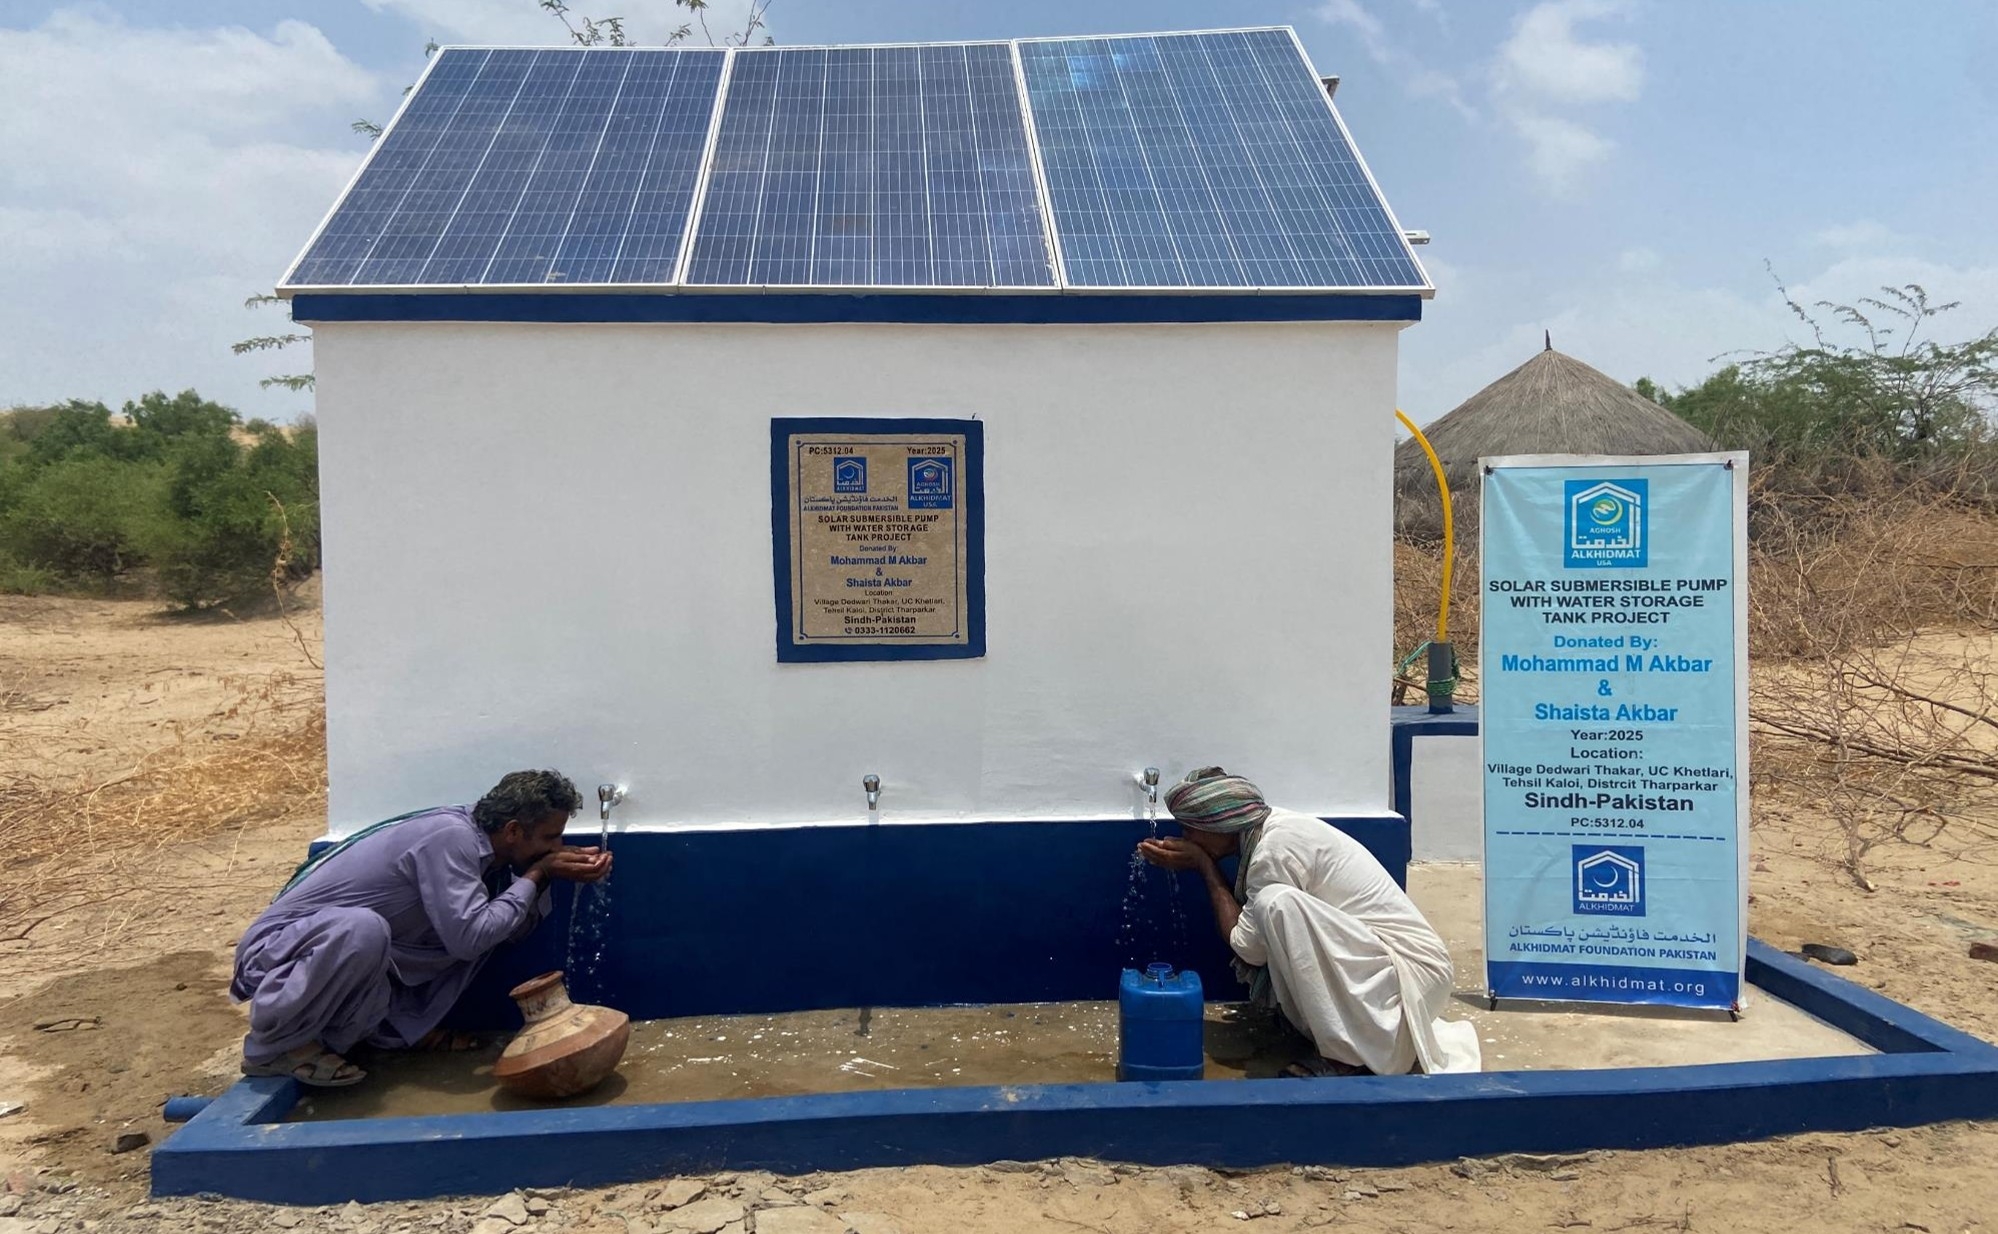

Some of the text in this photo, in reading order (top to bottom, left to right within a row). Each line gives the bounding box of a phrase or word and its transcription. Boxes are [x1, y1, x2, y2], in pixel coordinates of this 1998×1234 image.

[809, 447, 854, 455] PC:5312.04
[907, 447, 946, 455] Year:2025
[818, 515, 848, 523] SOLAR
[850, 515, 912, 523] SUBMERSIBLE
[829, 524, 929, 532] WITH WATER STORAGE
[871, 533, 912, 541] PROJECT
[830, 555, 927, 565] Mohammad M Akbar
[1571, 550, 1641, 559] ALKHIDMAT
[875, 568, 883, 576] &
[846, 578, 912, 588] Shaista Akbar
[1489, 579, 1727, 592] SOLAR SUBMERSIBLE PUMP
[1510, 595, 1704, 608] WITH WATER STORAGE
[897, 606, 936, 614] Tharparkar
[844, 616, 916, 624] Sindh-Pakistan
[1543, 611, 1670, 624] TANK PROJECT
[855, 626, 915, 634] 0333-1120662
[1554, 636, 1658, 650] Donated By:
[1502, 655, 1712, 672] Mohammad M Akbar
[1598, 679, 1612, 696] &
[1535, 703, 1678, 721] Shaista Akbar
[1571, 730, 1643, 741] Year:2025
[1571, 747, 1643, 759] Location:
[1488, 764, 1733, 779] Village Dedwari Thakar, UC Khetlari,
[1503, 778, 1718, 792] Tehsil Kaloi, Distrcit Tharparkar
[1525, 792, 1694, 811] Sindh-Pakistan
[1571, 818, 1644, 829] PC:5312.04
[1579, 903, 1634, 912] ALKHIDMAT
[1509, 925, 1575, 943] پاکستان
[1653, 932, 1716, 944] الخدمت
[1509, 943, 1716, 961] ALKHIDMAT FOUNDATION PAKISTAN
[1522, 974, 1705, 996] www.alkhidmat.org
